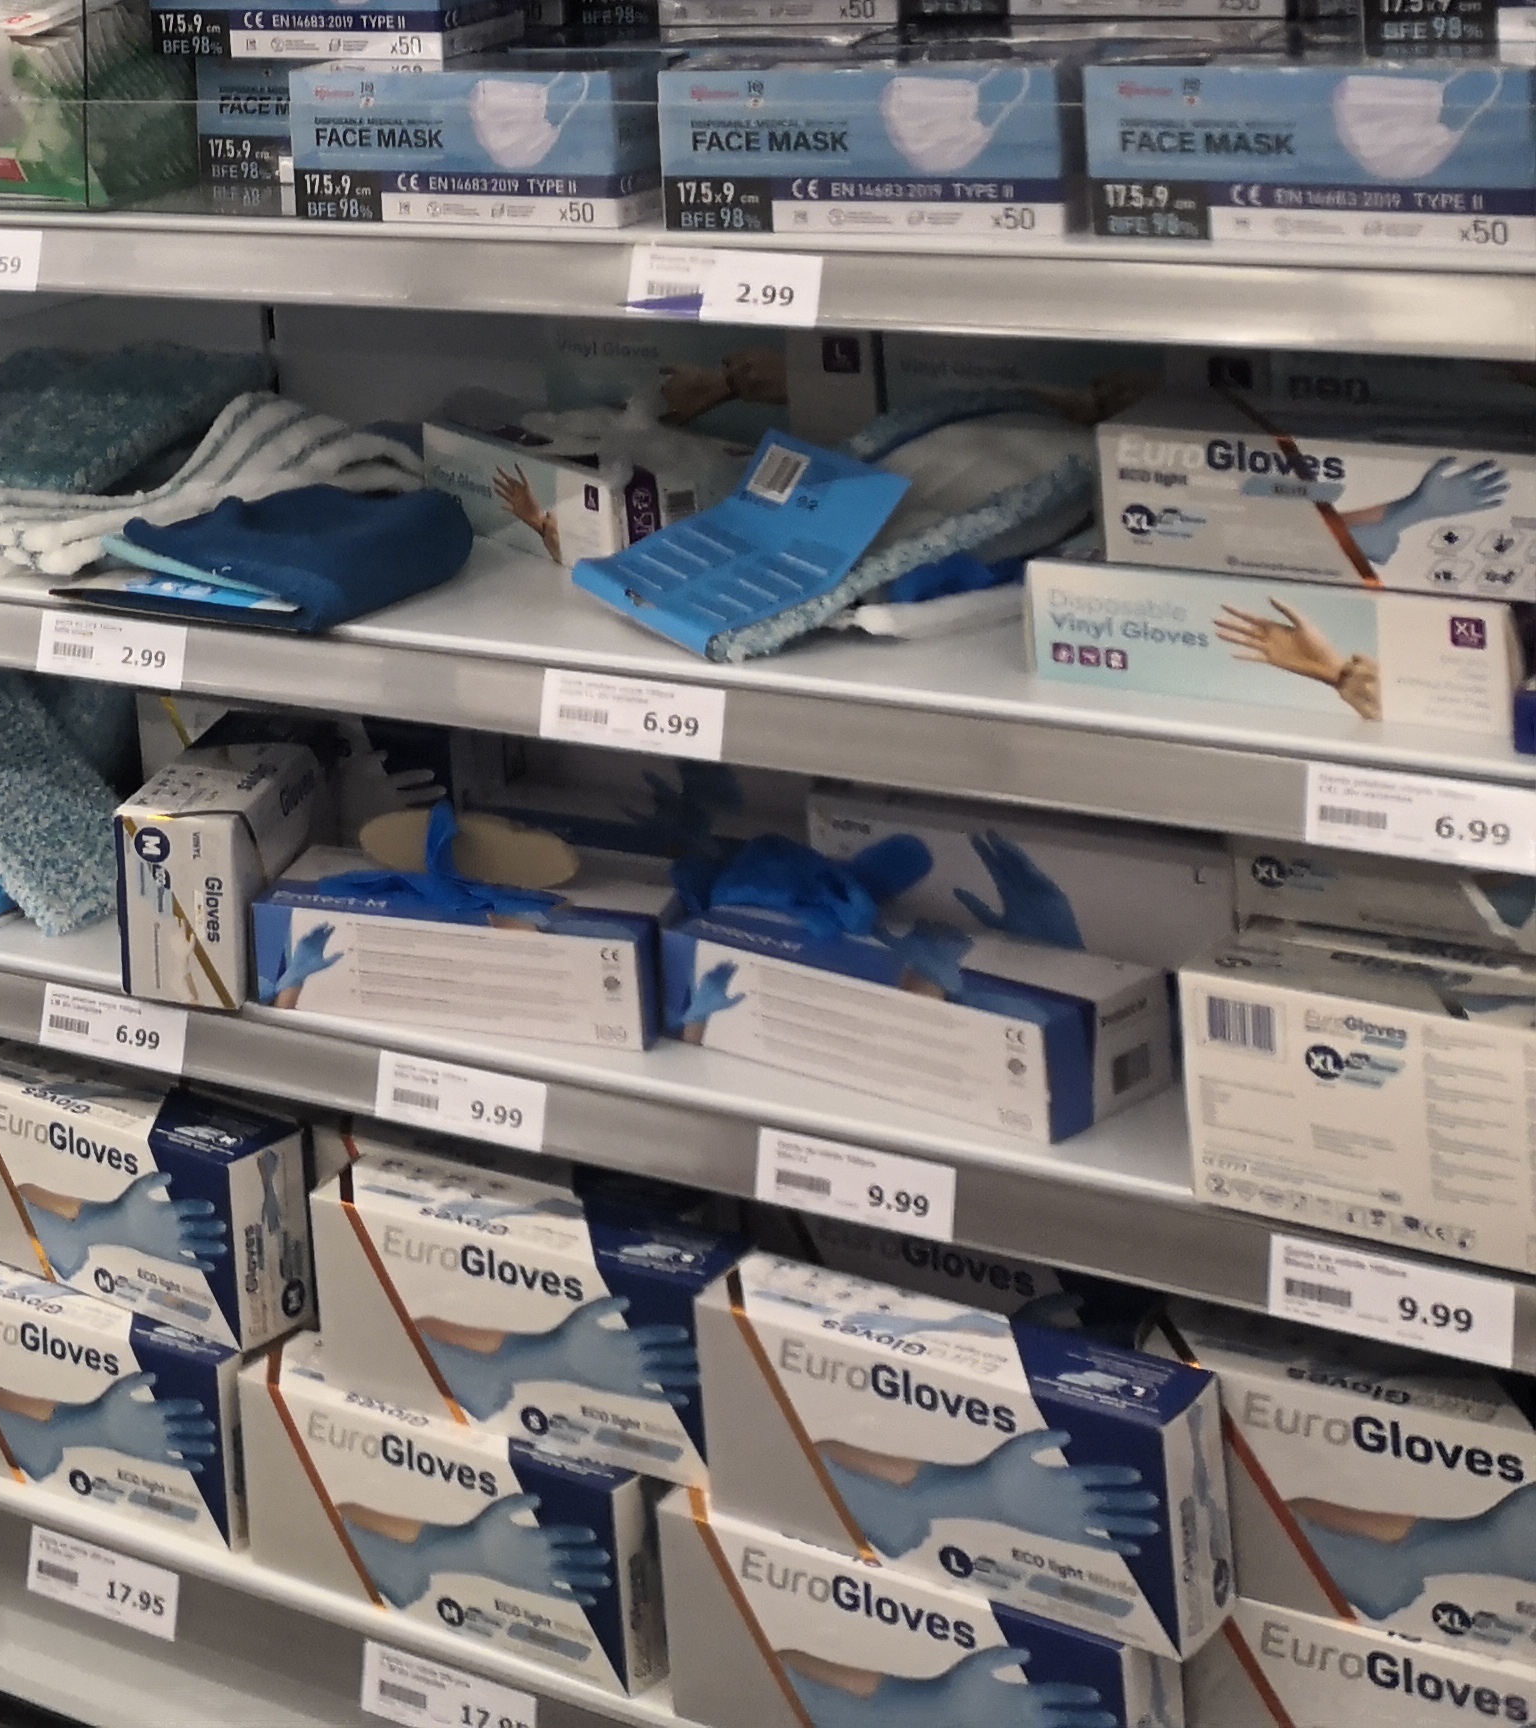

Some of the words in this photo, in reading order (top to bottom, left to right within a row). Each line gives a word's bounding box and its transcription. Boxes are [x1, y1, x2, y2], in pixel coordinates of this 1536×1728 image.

[272, 16, 290, 28] EN
[360, 16, 395, 29] TYPE
[163, 39, 190, 54] BFE
[390, 36, 422, 56] x50
[315, 128, 371, 148] FACE
[377, 128, 443, 148] MASK
[691, 129, 762, 153] FACE
[767, 129, 849, 154] MASK
[1120, 129, 1198, 155] FACE
[1204, 131, 1295, 158] MASK
[304, 174, 351, 196] 17.5x9
[355, 186, 371, 196] cm
[429, 178, 448, 191] EN
[527, 178, 564, 193] TYPE
[308, 202, 336, 217] BFE
[559, 202, 594, 223] x50
[680, 211, 716, 230] BFE
[991, 206, 1036, 232] x50
[1459, 219, 1509, 246] x50
[736, 282, 795, 308] 2.99
[1050, 613, 1114, 640] Vinyl
[1120, 620, 1210, 648] Gloves
[1454, 621, 1482, 640] XL
[122, 646, 166, 668] 2.99
[643, 712, 699, 737] 6.99
[1435, 816, 1510, 845] 6.99
[205, 876, 223, 943] Gloves
[116, 1024, 160, 1050] 6.99
[471, 1100, 522, 1128] 9.99
[868, 1184, 929, 1217] 9.99
[382, 1223, 585, 1302] EuroGloves
[1398, 1296, 1473, 1333] 9.99
[779, 1336, 1017, 1434] EuroGloves
[1242, 1389, 1524, 1483] EuroGloves
[307, 1411, 499, 1499] EuroGloves
[1012, 1548, 1046, 1567] ECO
[1048, 1557, 1084, 1583] light
[106, 1581, 166, 1616] 17.95
[740, 1548, 977, 1651] EuroGloves
[1258, 1620, 1529, 1725] EuroGloves
